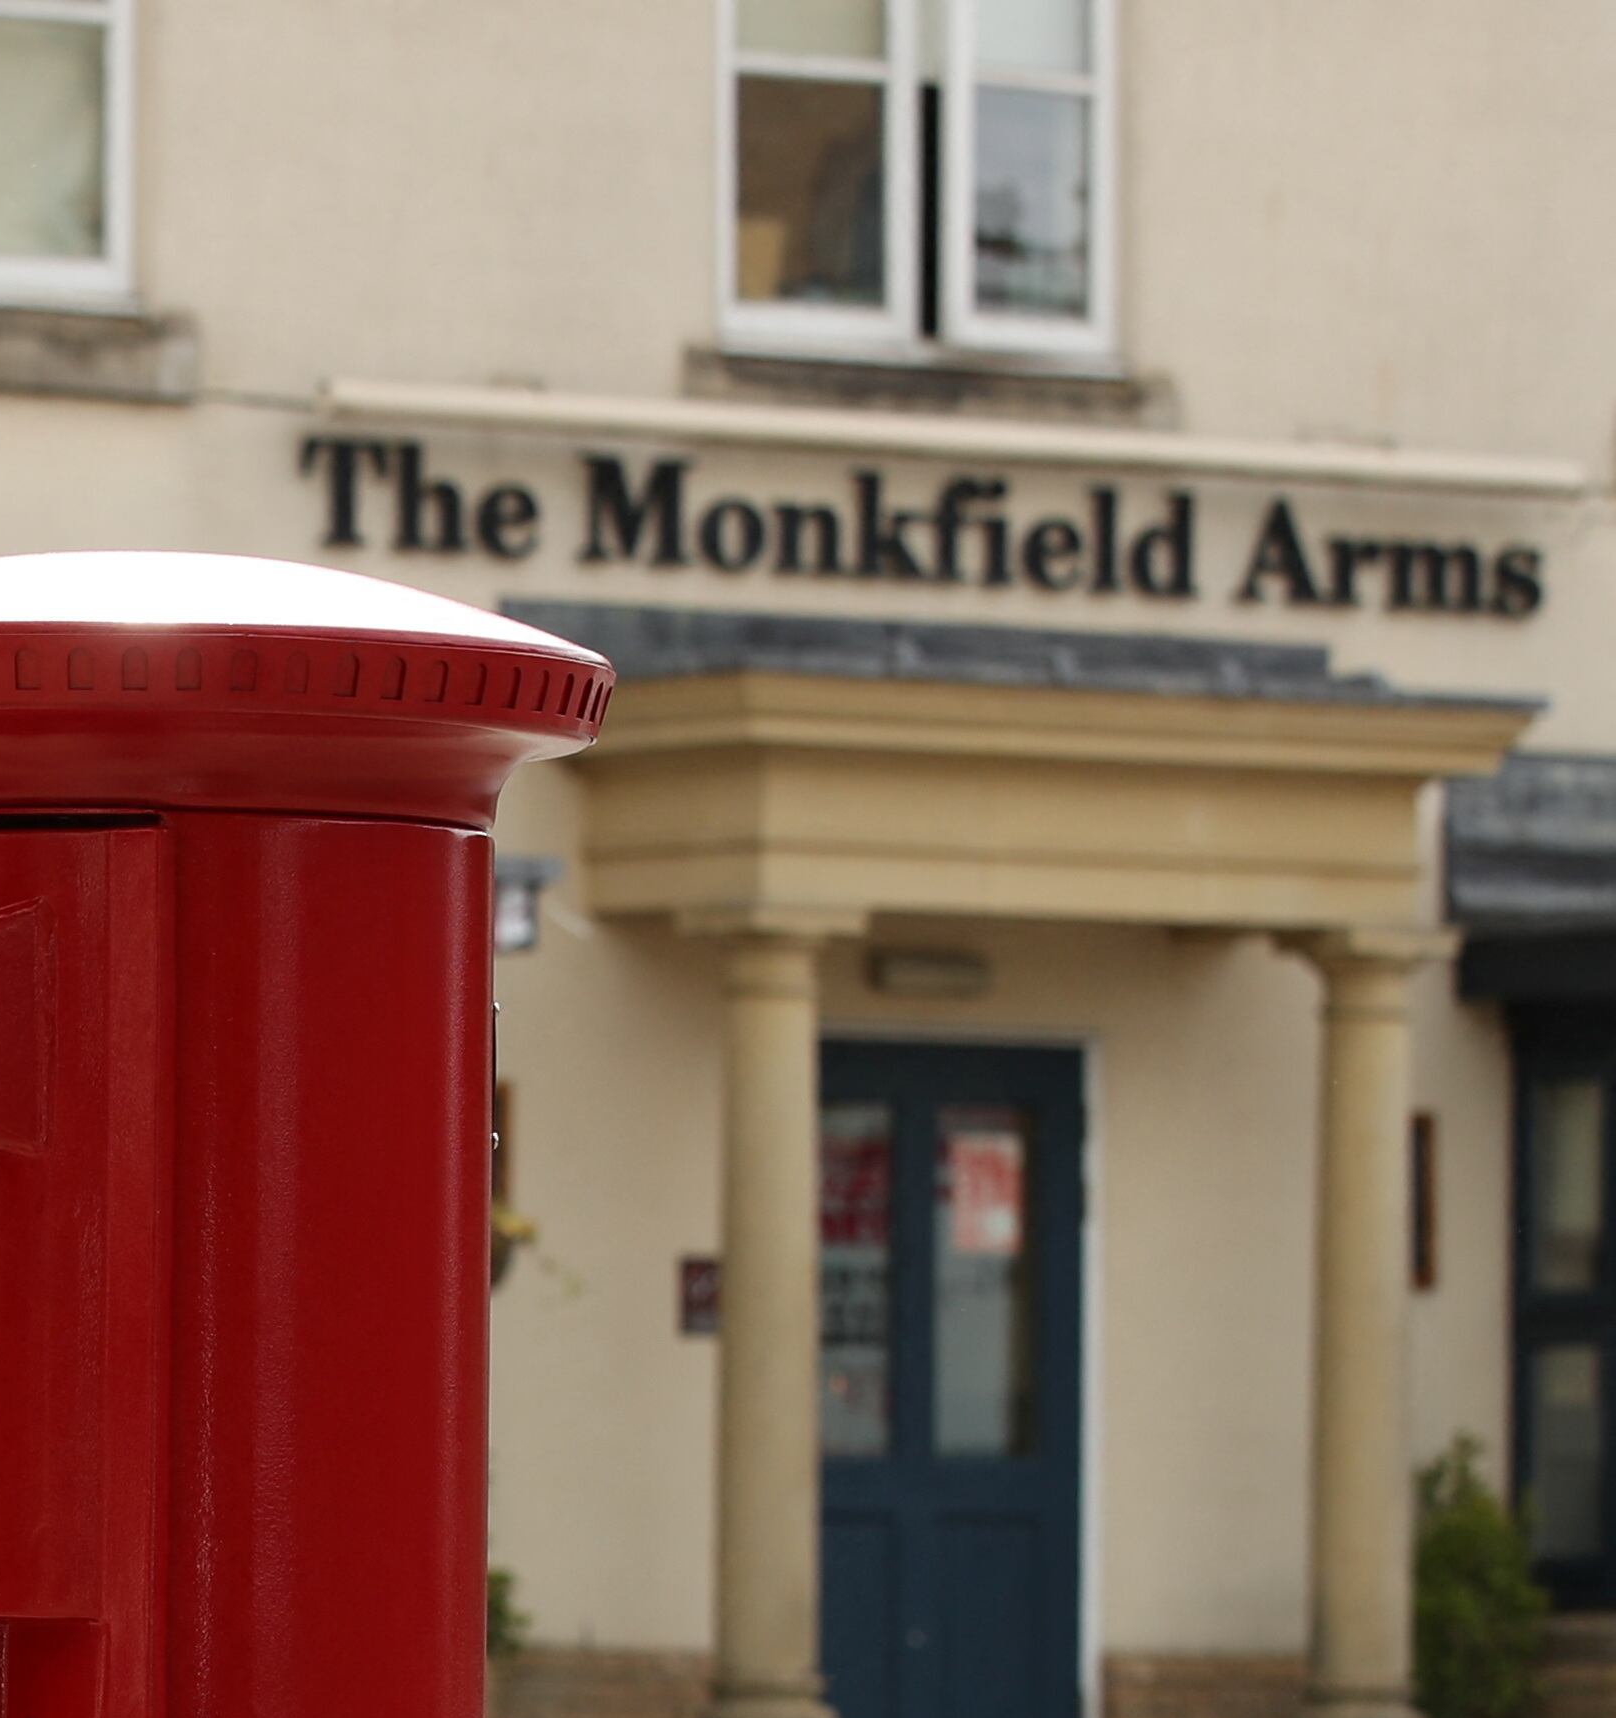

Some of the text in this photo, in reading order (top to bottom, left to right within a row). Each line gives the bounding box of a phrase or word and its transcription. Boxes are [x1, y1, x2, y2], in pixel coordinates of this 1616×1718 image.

[300, 435, 1543, 616] The Monkfield Arms
